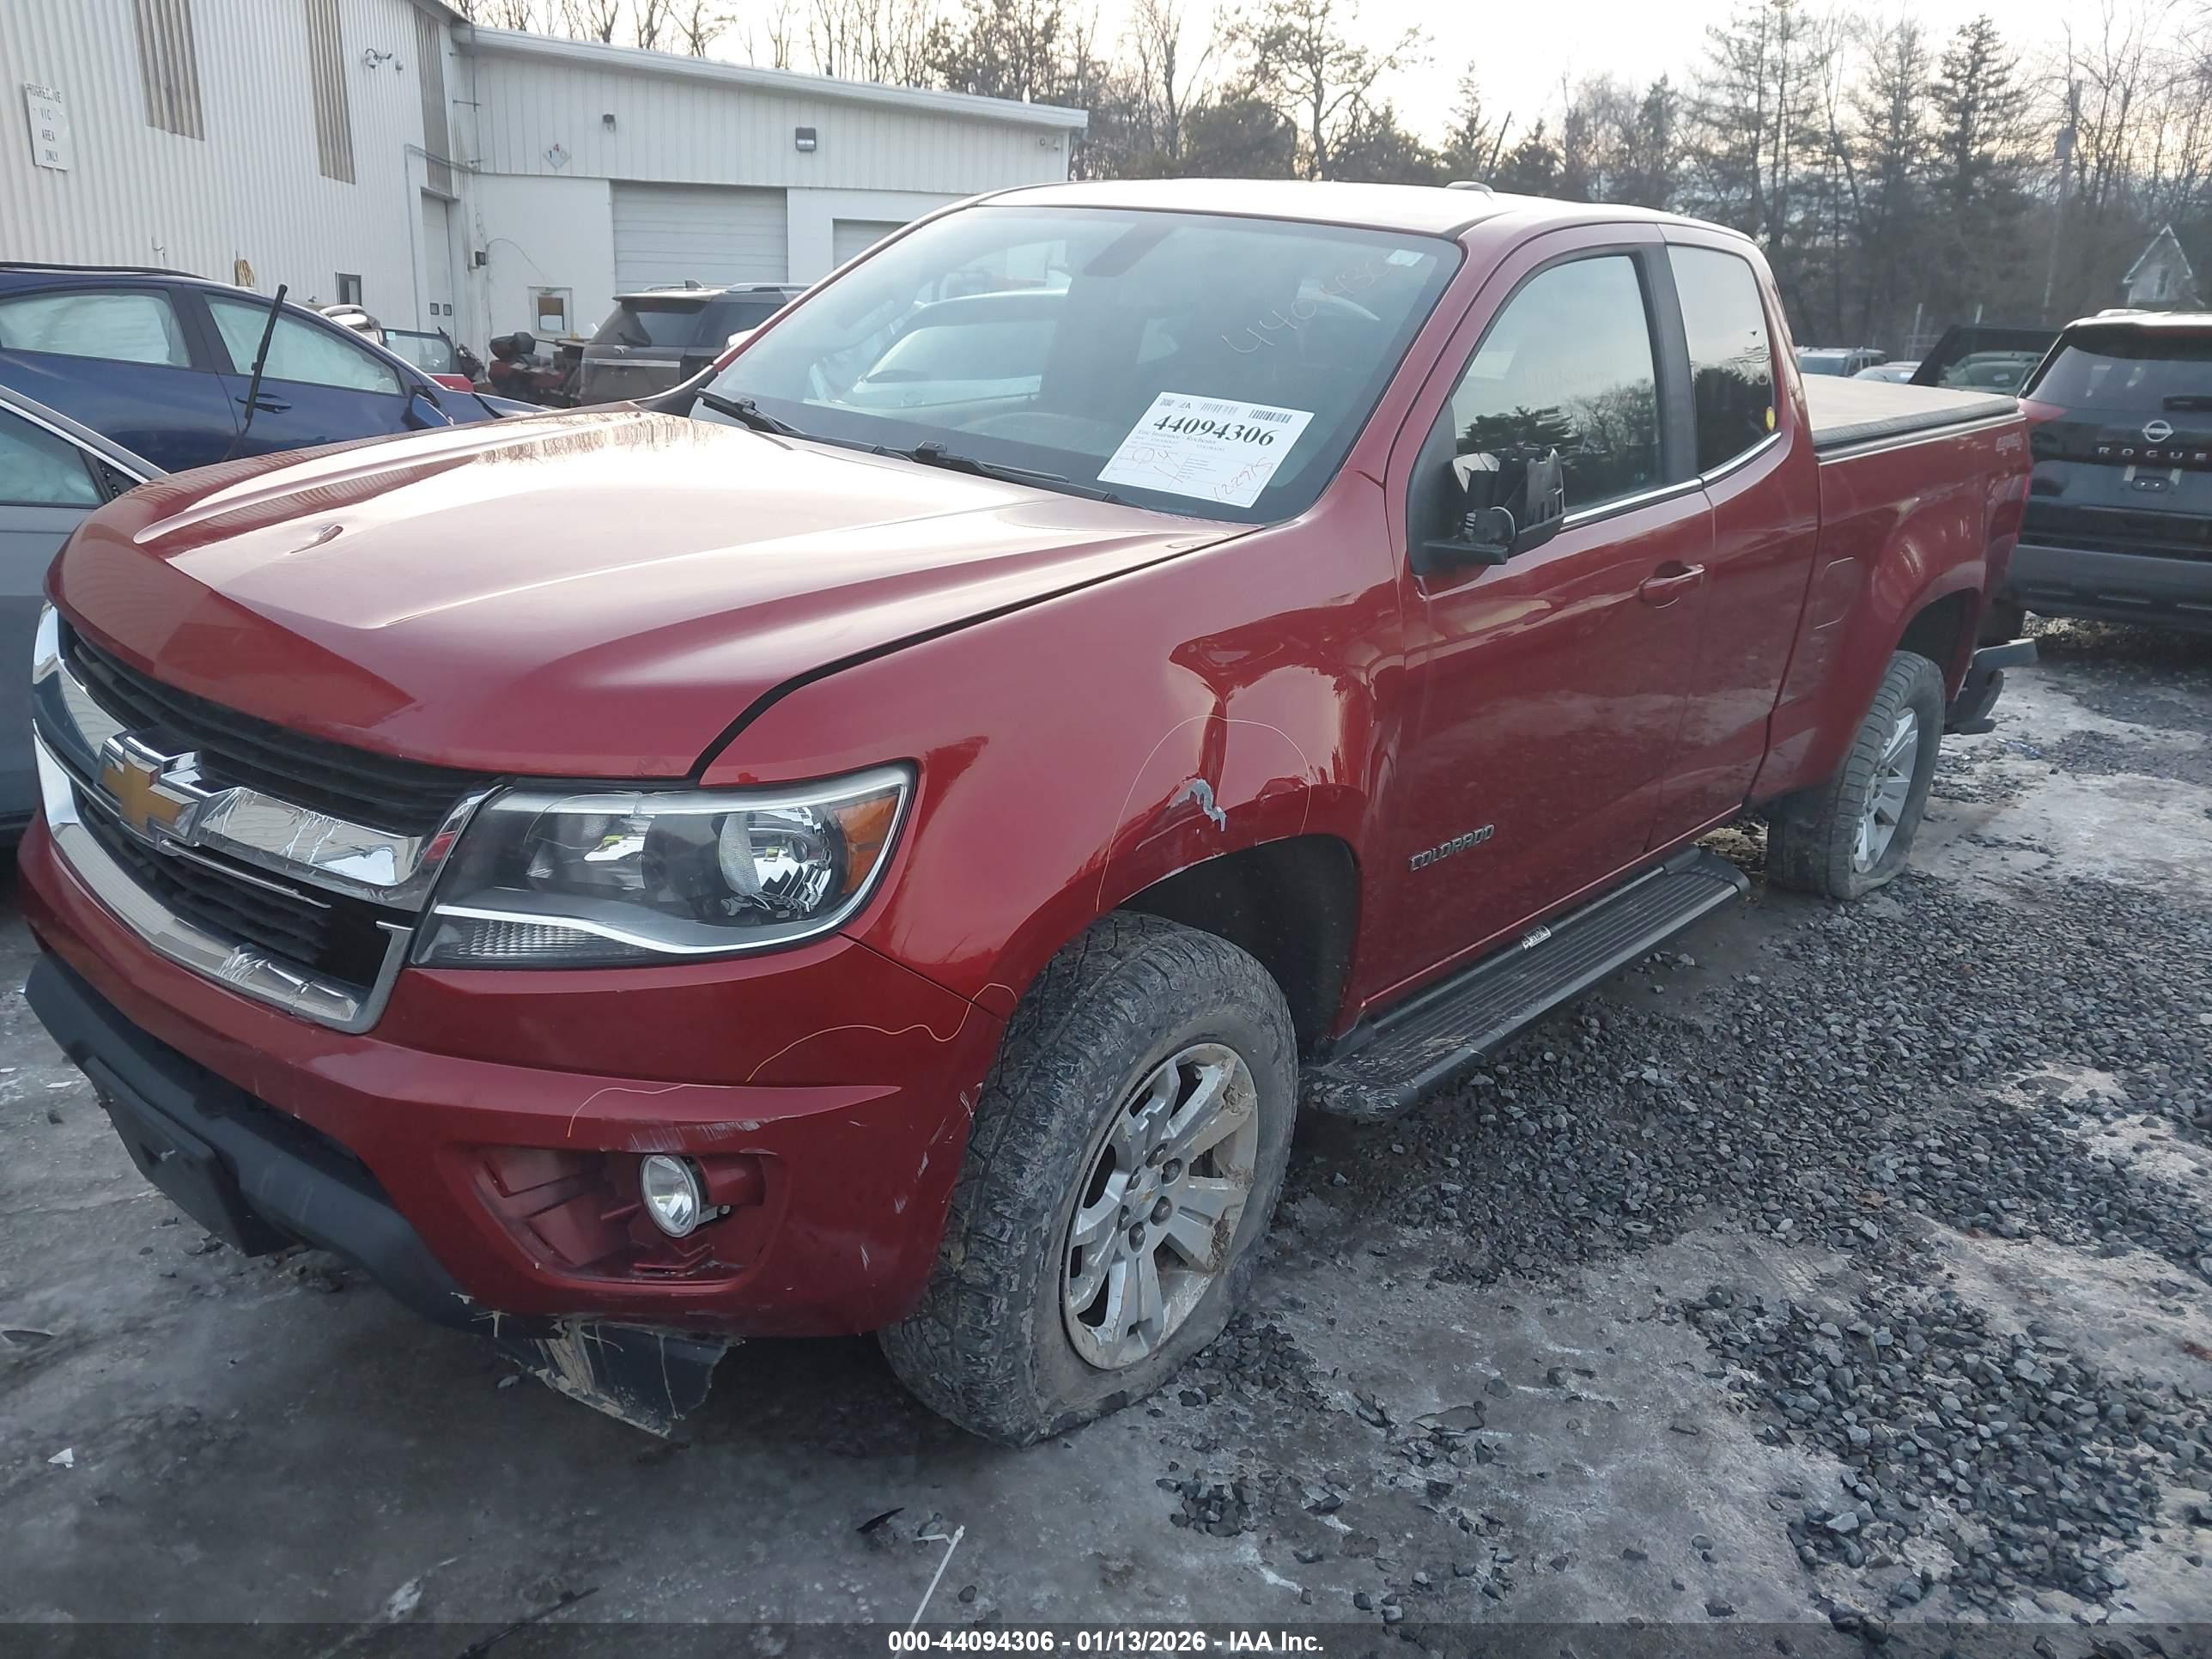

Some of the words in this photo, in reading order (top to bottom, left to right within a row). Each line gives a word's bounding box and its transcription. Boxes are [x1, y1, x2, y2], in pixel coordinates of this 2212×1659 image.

[41, 129, 55, 142] AREA
[1153, 415, 1280, 447] 44094306
[2098, 447, 2207, 461] ROGUE
[1410, 824, 1494, 872] COLORADO
